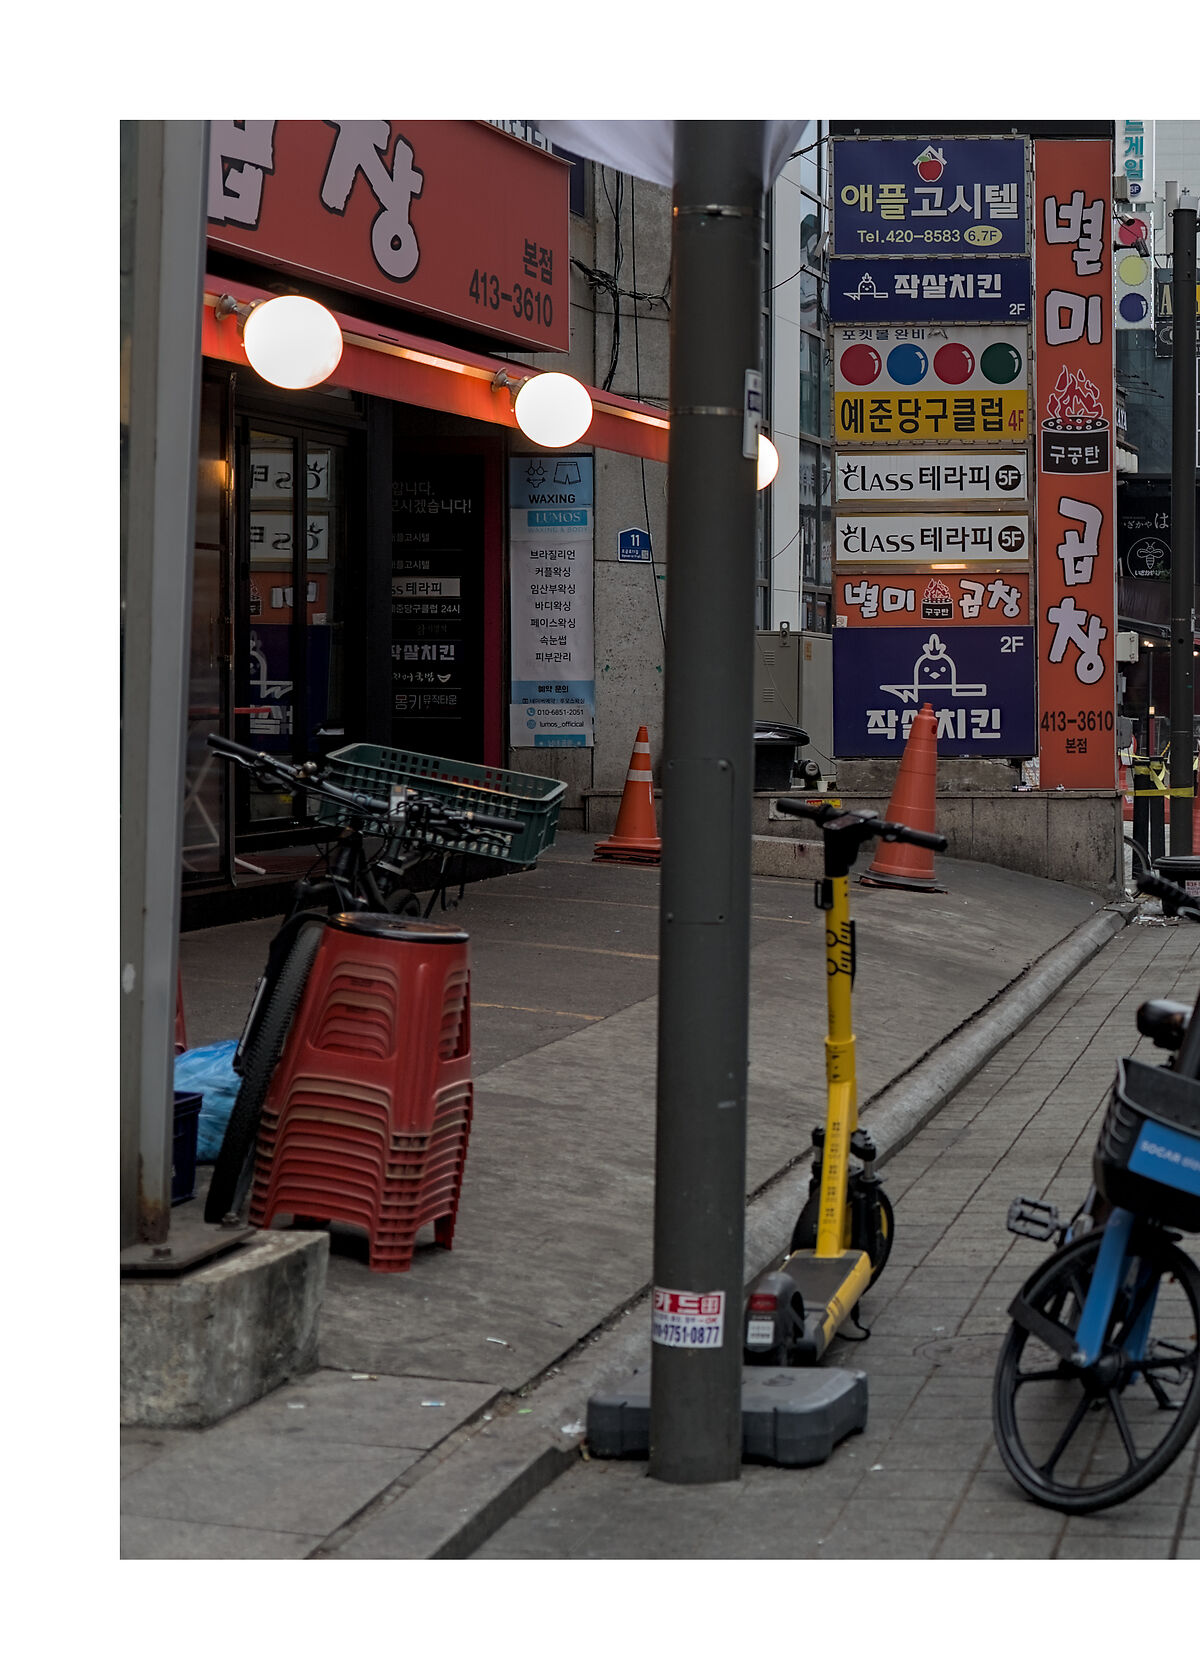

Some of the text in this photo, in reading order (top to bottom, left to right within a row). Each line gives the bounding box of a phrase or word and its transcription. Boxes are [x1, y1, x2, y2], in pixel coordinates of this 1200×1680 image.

[840, 183, 1019, 220] 애플고시텔
[968, 230, 998, 242] 6.7F
[523, 238, 553, 284] 본점
[894, 273, 1002, 299] 작살치킨
[469, 270, 554, 327] 413-3610
[1009, 303, 1026, 316] 2F
[840, 397, 1024, 433] 예준당구클럽 4F
[1049, 445, 1100, 465] 구공탄
[919, 465, 990, 491] 테라피
[998, 470, 1019, 486] 5F
[529, 494, 576, 504] WAXING
[535, 512, 581, 523] LUMOS
[630, 534, 640, 546] 11
[920, 526, 993, 553] 테라피
[1001, 530, 1022, 547] 5F
[530, 549, 576, 561] 브라질리언
[535, 567, 571, 578] 커플왁싱
[530, 584, 576, 595] 임산부왁싱
[1047, 496, 1107, 685] 곱창
[535, 601, 571, 612] 바디왁싱
[844, 579, 1022, 618] 별미 구공탄 곱창
[530, 618, 576, 629] 페이스왁싱
[539, 635, 567, 646] 속눈썹
[1000, 636, 1024, 653] 2F
[535, 652, 571, 662] 피부관리
[1041, 710, 1113, 732] 413-3610
[1065, 738, 1087, 754] 본점
